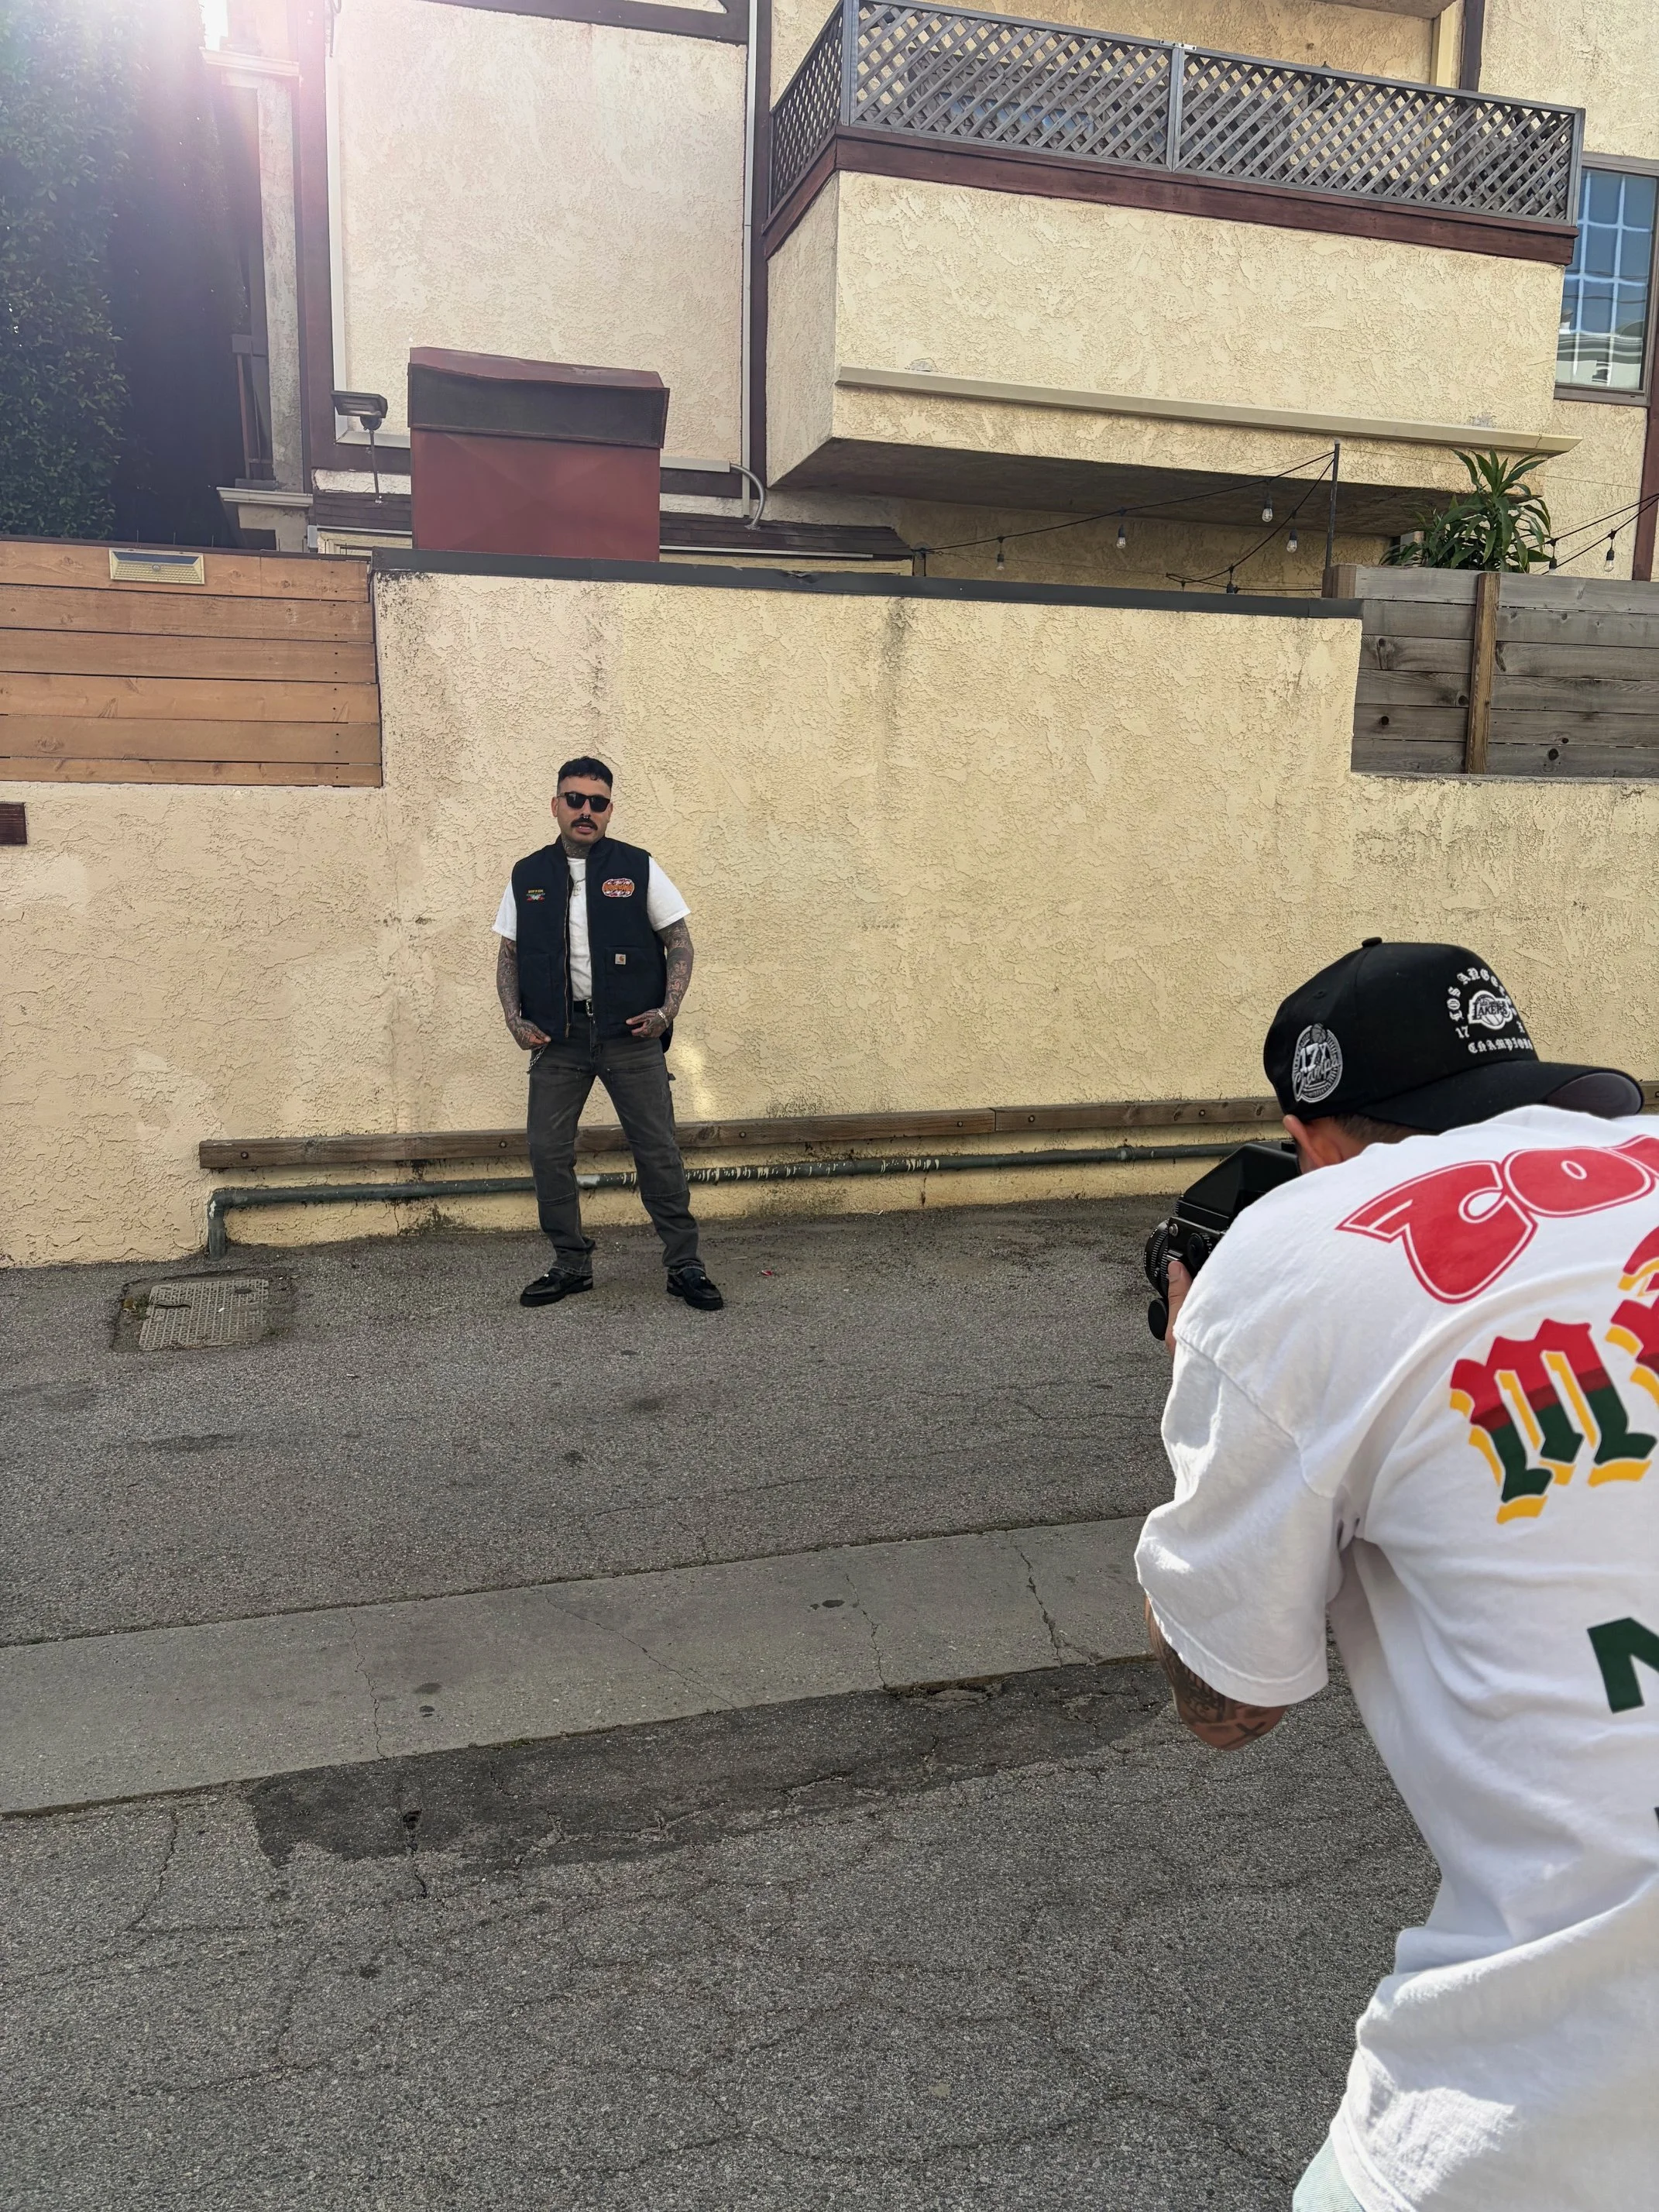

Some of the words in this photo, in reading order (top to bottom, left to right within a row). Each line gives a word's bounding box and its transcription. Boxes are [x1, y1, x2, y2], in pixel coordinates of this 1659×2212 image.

[1457, 967, 1517, 1015] ANGE
[1472, 1000, 1510, 1020] LAKERS
[1455, 1025, 1470, 1038] 17
[1468, 1037, 1534, 1054] CHAMPION
